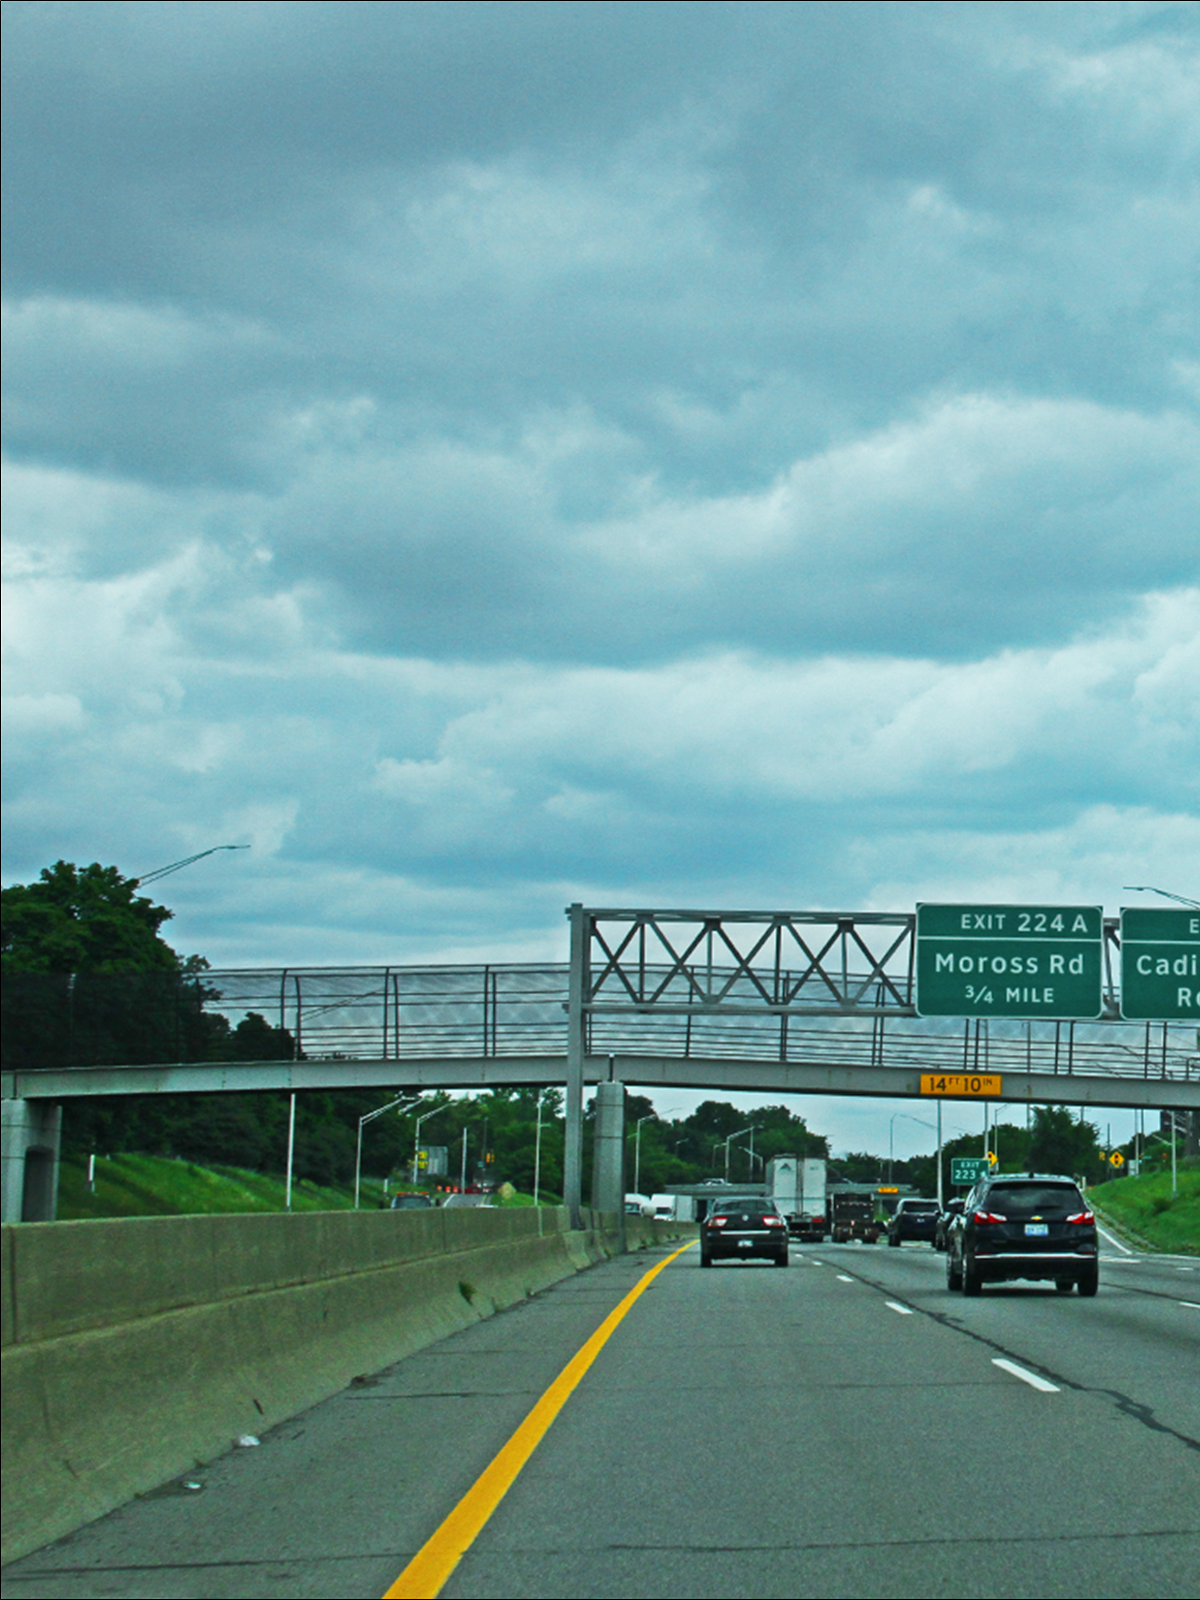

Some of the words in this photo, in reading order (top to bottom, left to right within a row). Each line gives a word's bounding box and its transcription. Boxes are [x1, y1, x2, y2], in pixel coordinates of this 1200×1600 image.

[961, 914, 1006, 930] EXIT
[935, 953, 1039, 974] Moross
[1050, 954, 1084, 975] Rd
[1006, 988, 1054, 1003] MILE
[960, 1161, 980, 1169] EXIT
[955, 1170, 976, 1180] 223
